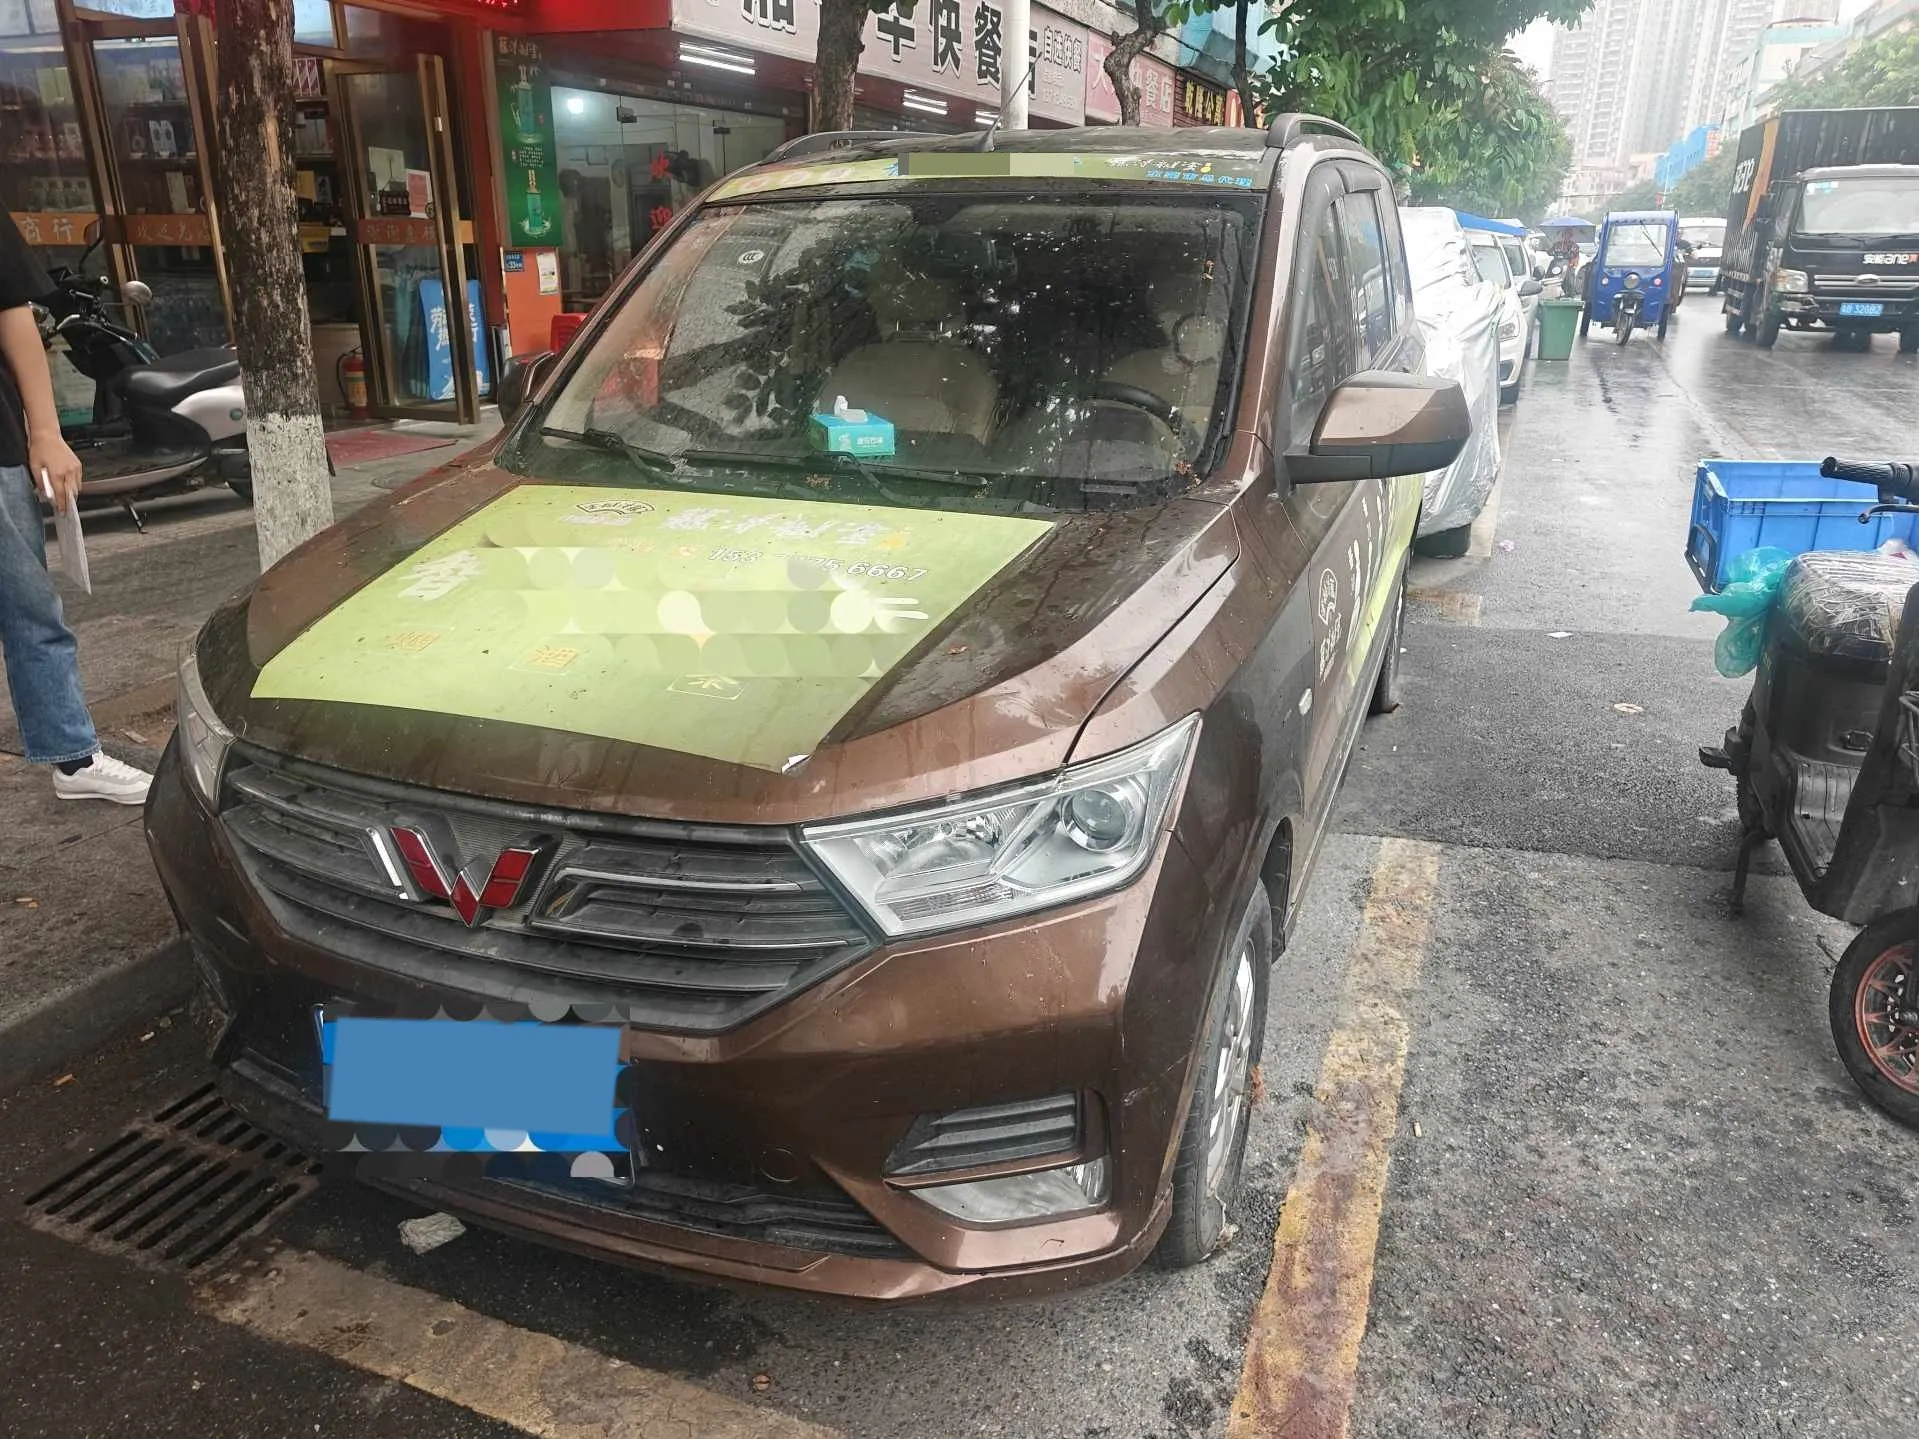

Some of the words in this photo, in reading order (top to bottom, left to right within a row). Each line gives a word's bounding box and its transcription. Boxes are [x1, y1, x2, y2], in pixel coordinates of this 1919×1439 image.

[1043, 25, 1082, 74] 自选快餐
[21, 215, 73, 242] 商行
[846, 562, 929, 583] 6667
